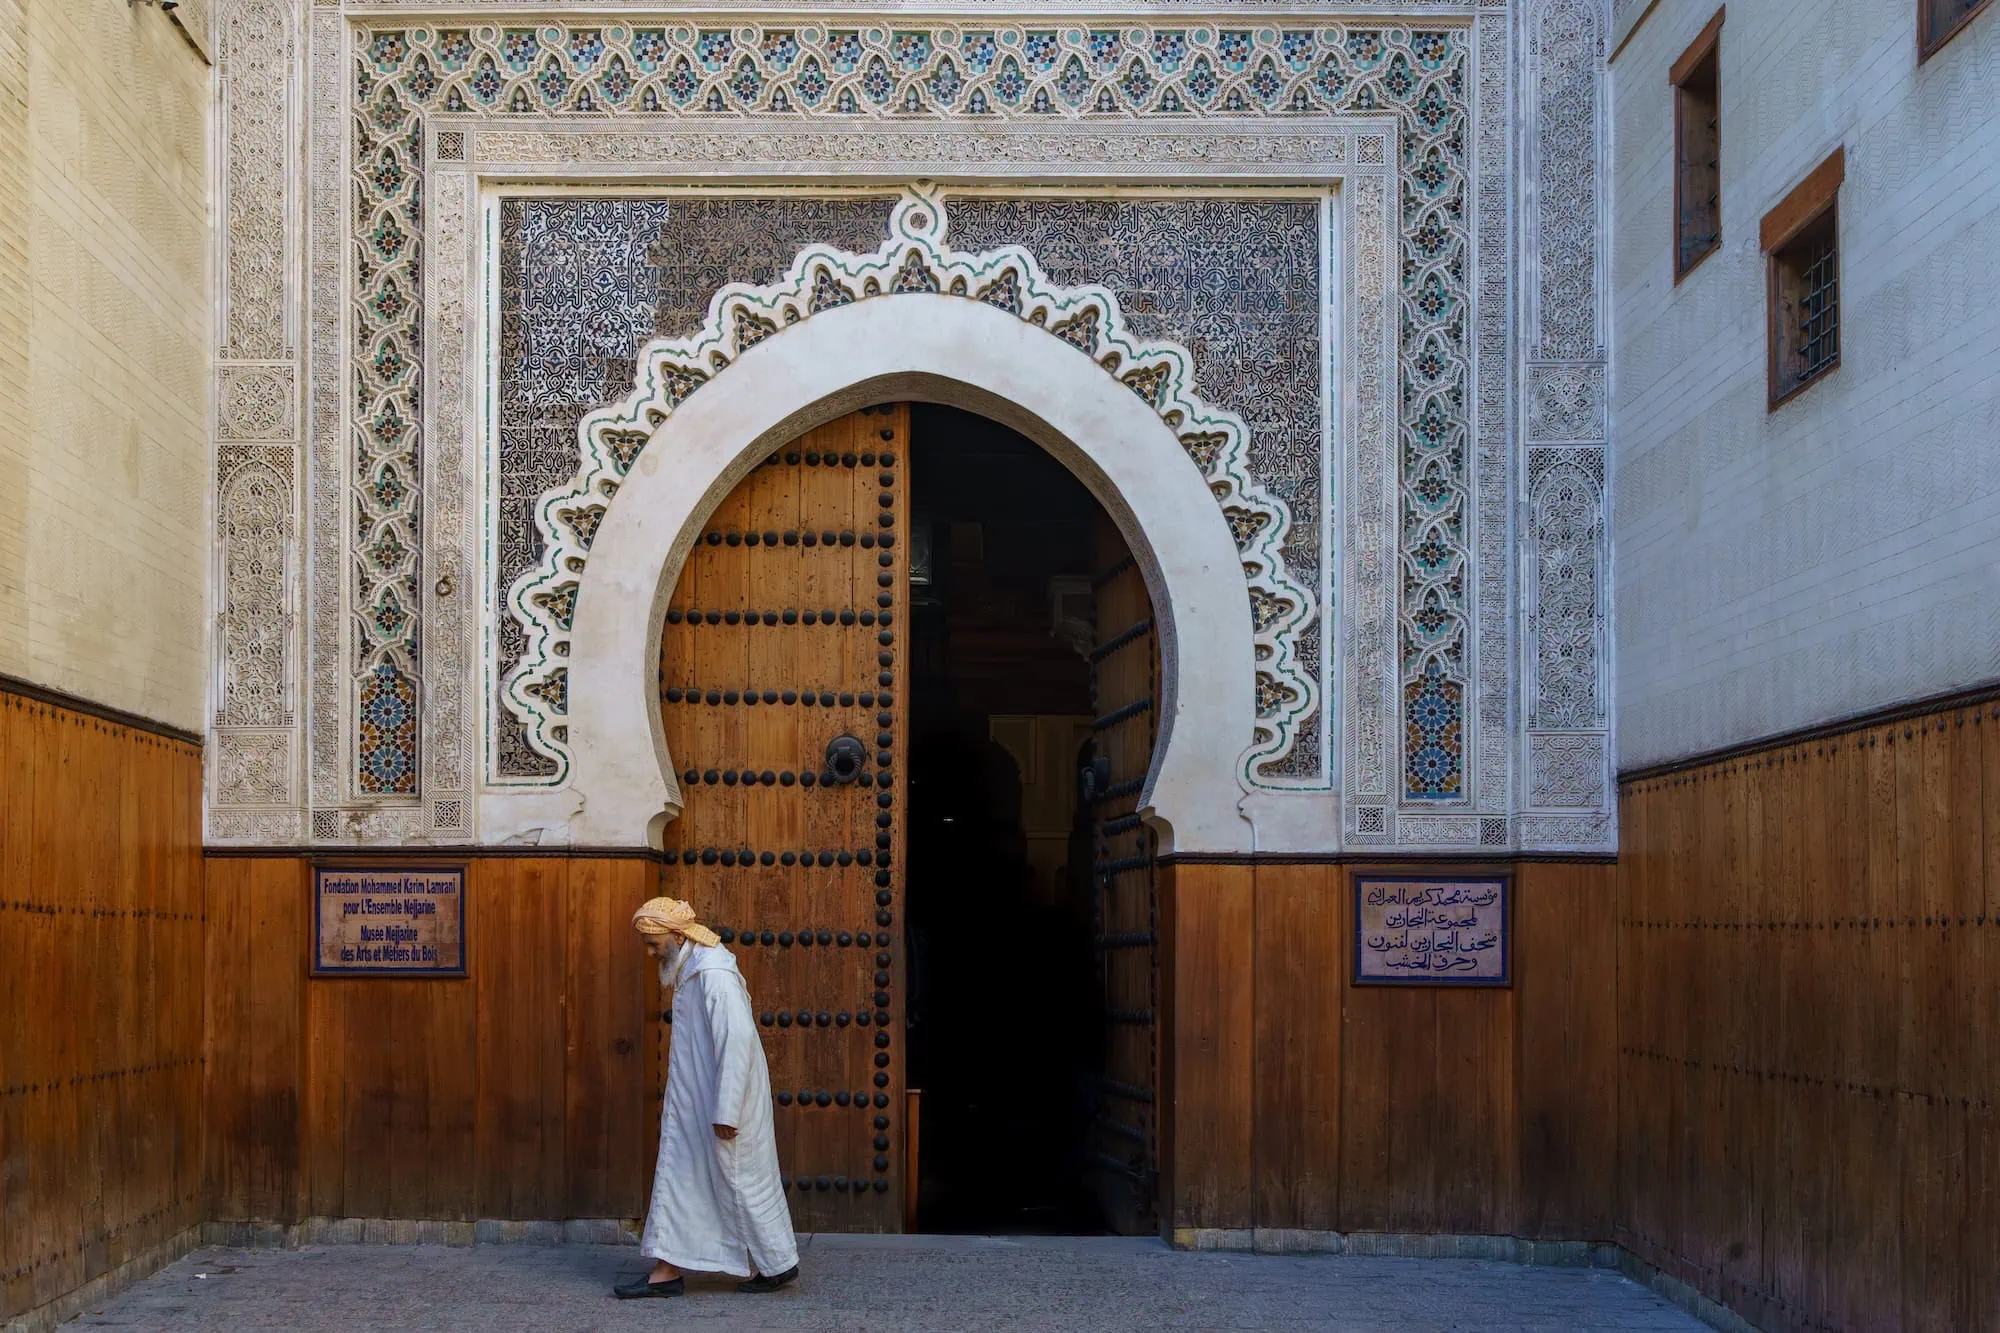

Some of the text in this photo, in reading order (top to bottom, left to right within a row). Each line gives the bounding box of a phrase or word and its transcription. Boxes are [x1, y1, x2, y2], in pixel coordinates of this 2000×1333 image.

[324, 877, 456, 894] Fondation Mohammed Karim Lamrani
[1367, 887, 1498, 907] مؤسسة محمد كريم العمراني
[343, 898, 436, 918] pour L'Ensemble Nejjarine
[1385, 907, 1478, 930] لمجموعة النجارين
[360, 925, 418, 945] Musée Nejjarine
[1367, 929, 1498, 953] متحف النجارين لفنون
[341, 945, 438, 961] des Arts et Métiers du Bois
[1385, 952, 1478, 971] وحرف الخشب
